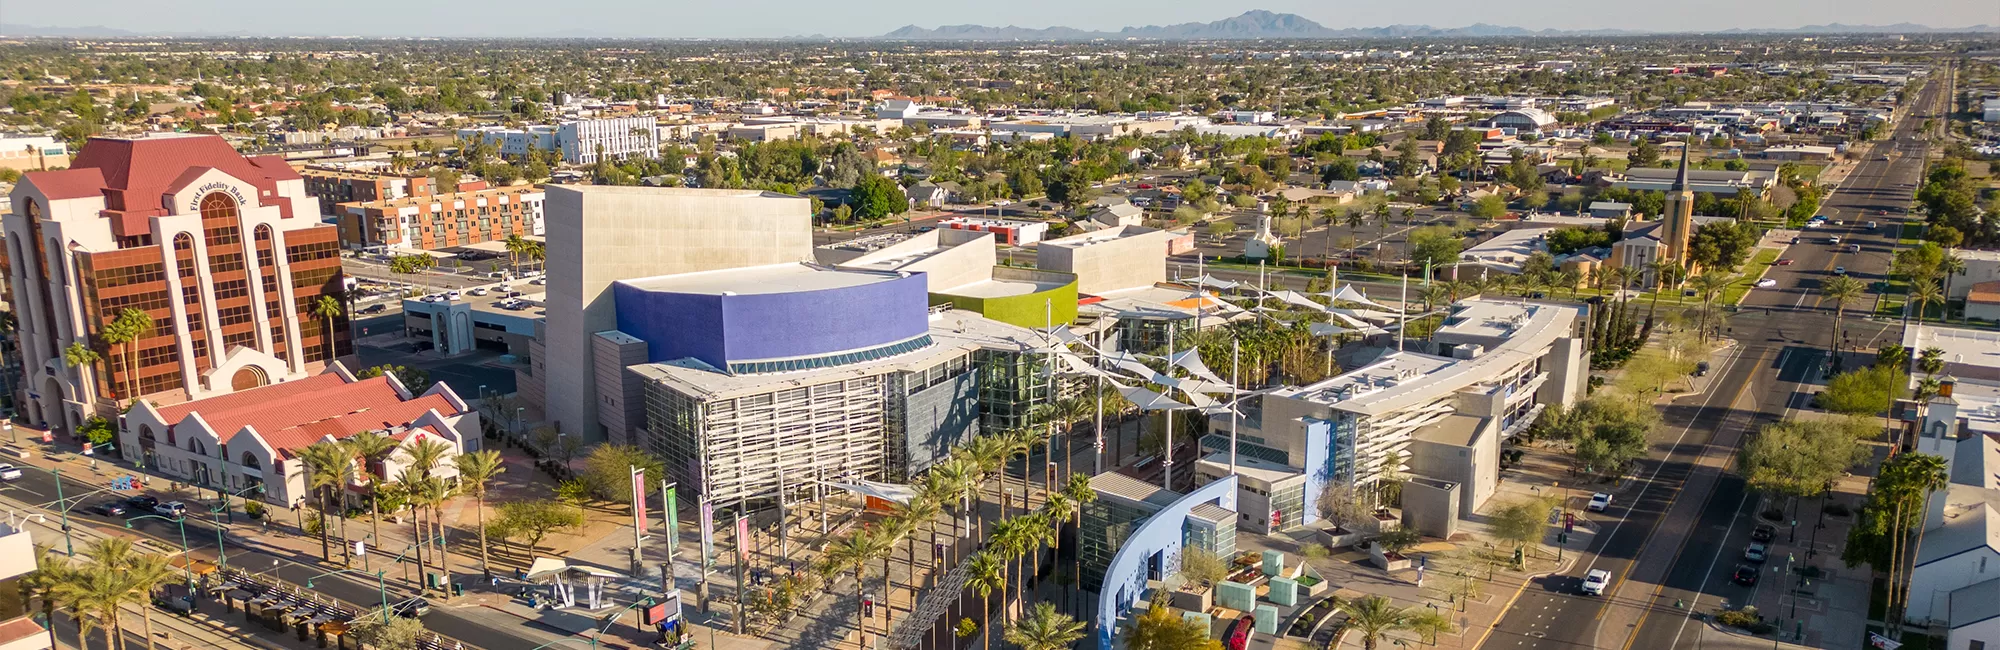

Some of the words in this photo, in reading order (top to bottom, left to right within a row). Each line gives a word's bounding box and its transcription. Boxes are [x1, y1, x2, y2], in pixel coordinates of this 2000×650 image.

[190, 192, 201, 211] First
[199, 181, 230, 194] Fidelity
[230, 186, 247, 206] Bank
